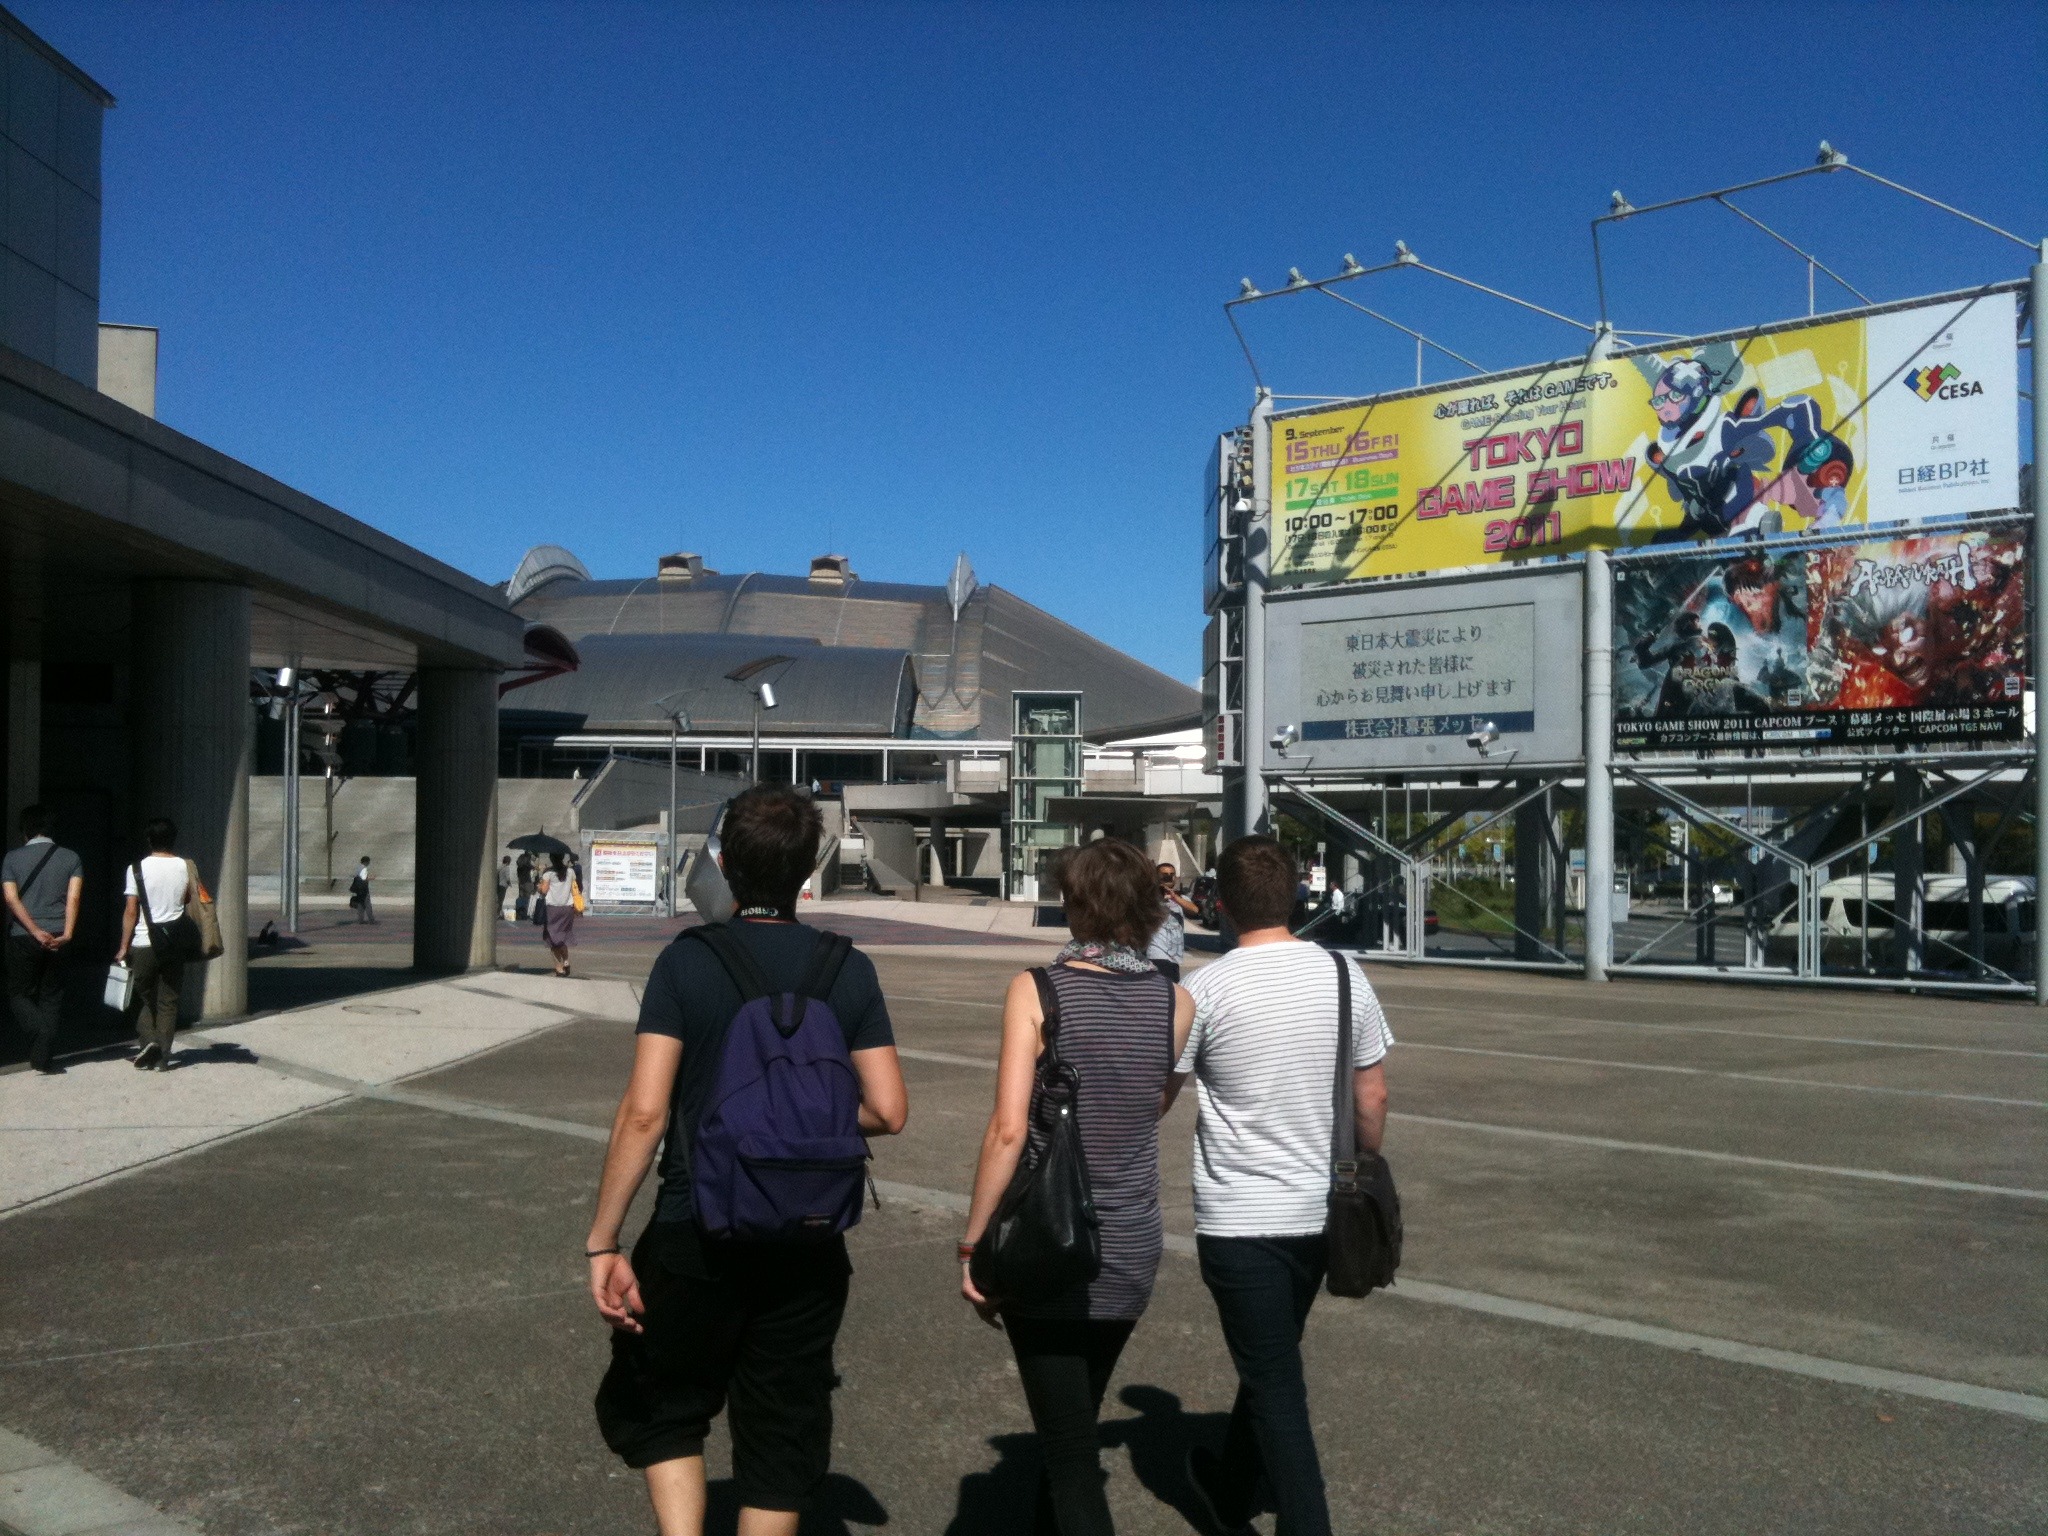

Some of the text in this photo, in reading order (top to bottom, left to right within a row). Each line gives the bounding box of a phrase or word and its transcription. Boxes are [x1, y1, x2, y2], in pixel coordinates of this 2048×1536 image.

[1939, 381, 1983, 401] CESA
[1535, 403, 1558, 416] Your
[1299, 426, 1345, 439] September
[1463, 419, 1583, 471] TOKYO
[1898, 458, 1990, 485] 日経BP社
[1416, 456, 1635, 520] GAME SHOW
[1483, 511, 1562, 553] 2011
[1346, 625, 1483, 653] 東日本大震災により
[1352, 655, 1474, 680] 被災された皆様に
[1316, 678, 1515, 707] 心からお見舞い申し上げます
[1617, 722, 1652, 734] TOKYO
[1655, 721, 1685, 732] GAME
[1687, 719, 1721, 731] SHOW
[1723, 718, 1750, 729] 2011
[1754, 716, 1802, 728] CAPCOM
[1918, 723, 1958, 735] CAPCOM
[1979, 721, 2003, 731] NAVI
[741, 907, 779, 917] Canon
